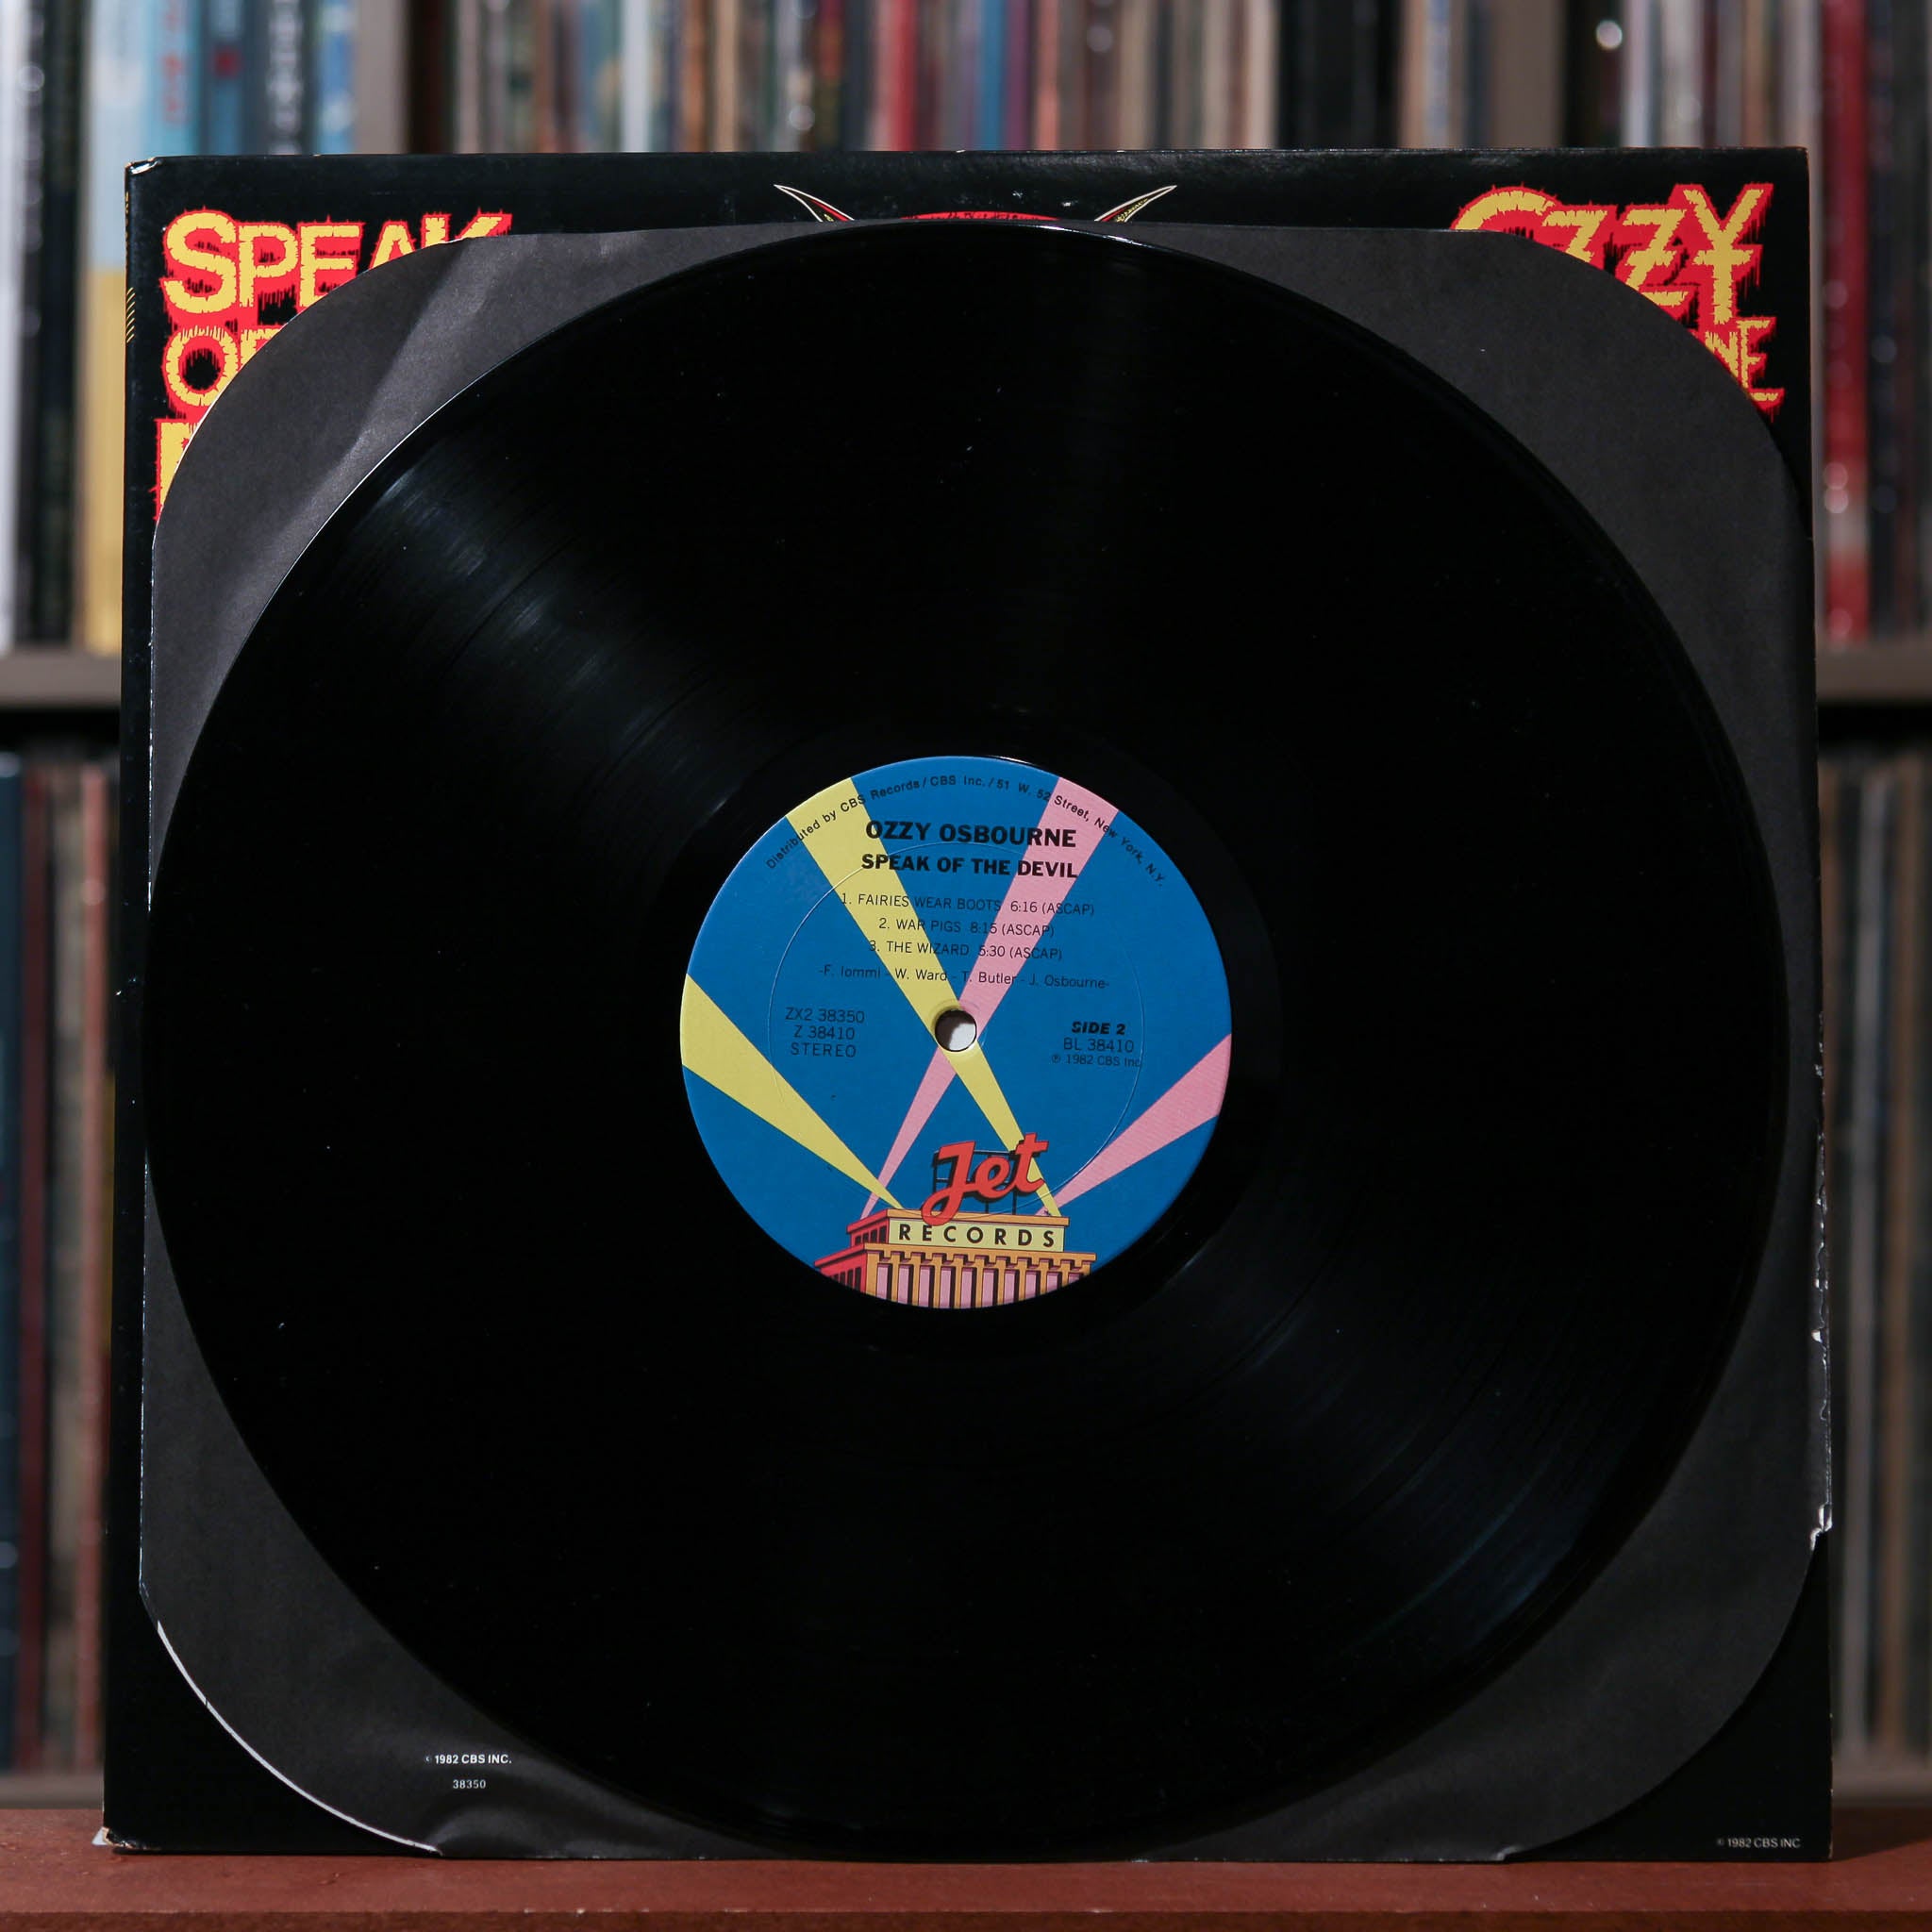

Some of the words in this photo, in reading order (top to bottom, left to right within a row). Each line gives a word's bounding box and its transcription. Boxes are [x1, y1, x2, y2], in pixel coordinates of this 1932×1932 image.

[766, 820, 822, 870] Distributed
[823, 810, 837, 823] by
[840, 794, 867, 812] CBS
[1036, 788, 1052, 801] 52
[1054, 794, 1090, 822] Street,
[1094, 817, 1118, 839] New
[865, 821, 931, 841] OZZY
[940, 823, 1077, 848] OSBOURNE
[861, 853, 930, 872] SPEAK
[937, 857, 966, 874] OF
[971, 858, 1010, 875] THE
[1017, 860, 1078, 878] DEVIL
[841, 893, 852, 906] 1.
[858, 894, 910, 908] FAIRIES
[914, 897, 952, 908] WEAR
[957, 898, 1002, 911] BOOTS
[1010, 900, 1038, 913] 6:16
[1041, 902, 1094, 916] (ASCAP)
[878, 918, 890, 930] 2.
[896, 919, 925, 931] WAR
[930, 920, 961, 933] PIGS
[970, 922, 998, 934] 8:15
[1001, 923, 1055, 938] (ASCAP)
[869, 940, 880, 952] 3.
[886, 941, 912, 954] THE
[917, 942, 970, 956] WIZARD
[978, 945, 1006, 958] 5:30
[1009, 946, 1062, 961] (ASCAP)
[841, 965, 882, 978] Iommi
[895, 968, 909, 980] W.
[915, 969, 947, 982] Ward
[961, 971, 972, 983] T.
[978, 971, 1017, 985] Butler
[785, 1007, 813, 1021] ZX2
[818, 1008, 865, 1024] 38350
[793, 1024, 803, 1038] Z
[808, 1025, 856, 1041] 38410
[1071, 1021, 1111, 1035] SIDE
[1116, 1024, 1126, 1036] 2
[791, 1041, 857, 1058] STEREO
[1063, 1037, 1082, 1051] BL
[1087, 1039, 1134, 1053] 38410
[1066, 1054, 1093, 1065] 1982
[1097, 1055, 1121, 1067] CBS
[921, 1132, 1049, 1226] Jet
[898, 1223, 1056, 1248] RECORDS
[434, 1754, 459, 1765] 1982
[461, 1754, 486, 1765] CBS
[488, 1754, 512, 1765] INC.
[453, 1779, 487, 1790] 38350
[1727, 1837, 1752, 1849] 1982
[1754, 1837, 1778, 1849] CBS
